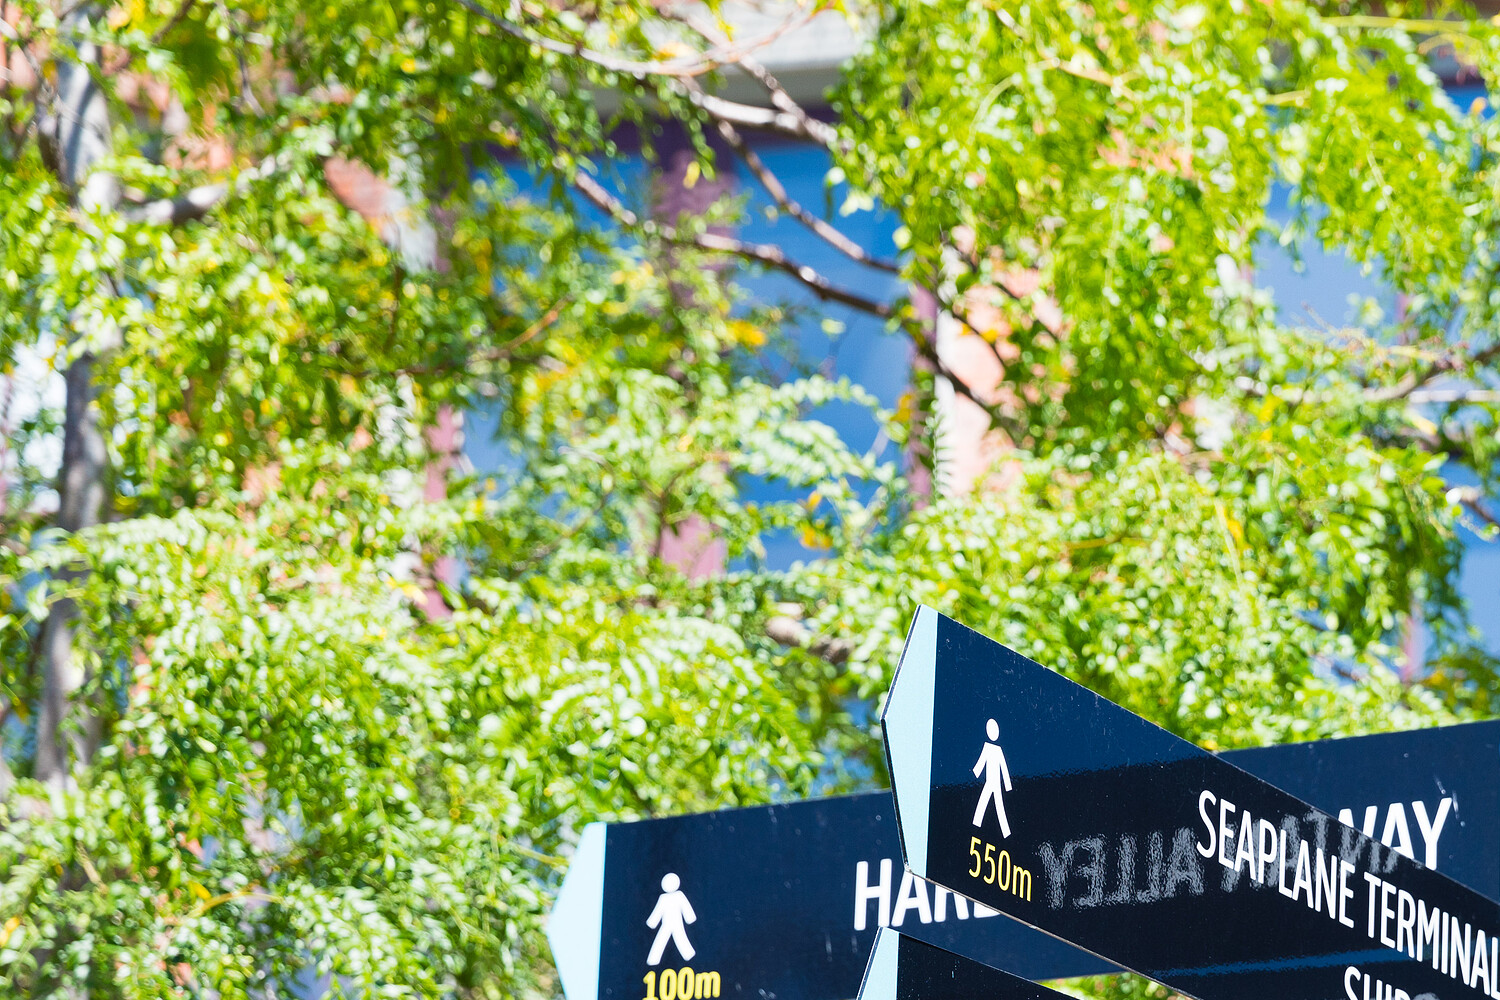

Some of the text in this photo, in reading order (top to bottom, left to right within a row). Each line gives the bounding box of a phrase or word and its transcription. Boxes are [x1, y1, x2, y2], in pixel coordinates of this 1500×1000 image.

[854, 858, 1001, 931] HA
[969, 837, 1031, 901] 550m
[1197, 790, 1356, 929] SEAPLANE
